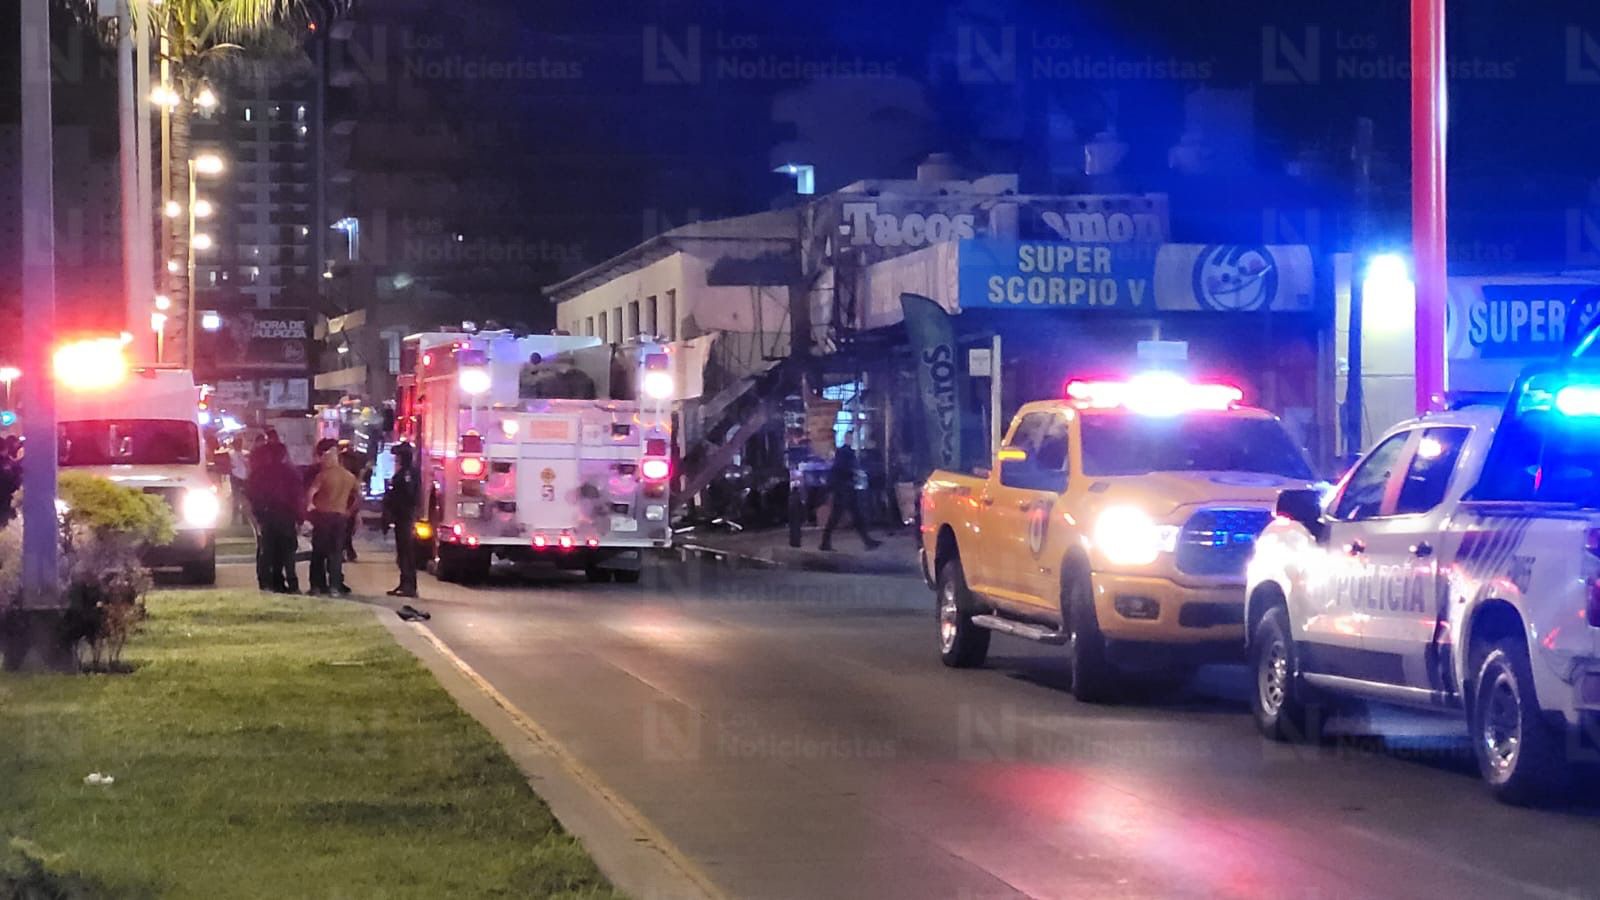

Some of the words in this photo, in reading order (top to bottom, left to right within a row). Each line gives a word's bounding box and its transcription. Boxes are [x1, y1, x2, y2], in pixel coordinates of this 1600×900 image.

[842, 203, 975, 246] Tacos
[1018, 245, 1112, 274] SUPER
[988, 276, 1118, 306] SCORPIO
[1128, 279, 1147, 306] V
[1470, 300, 1566, 345] SUPER
